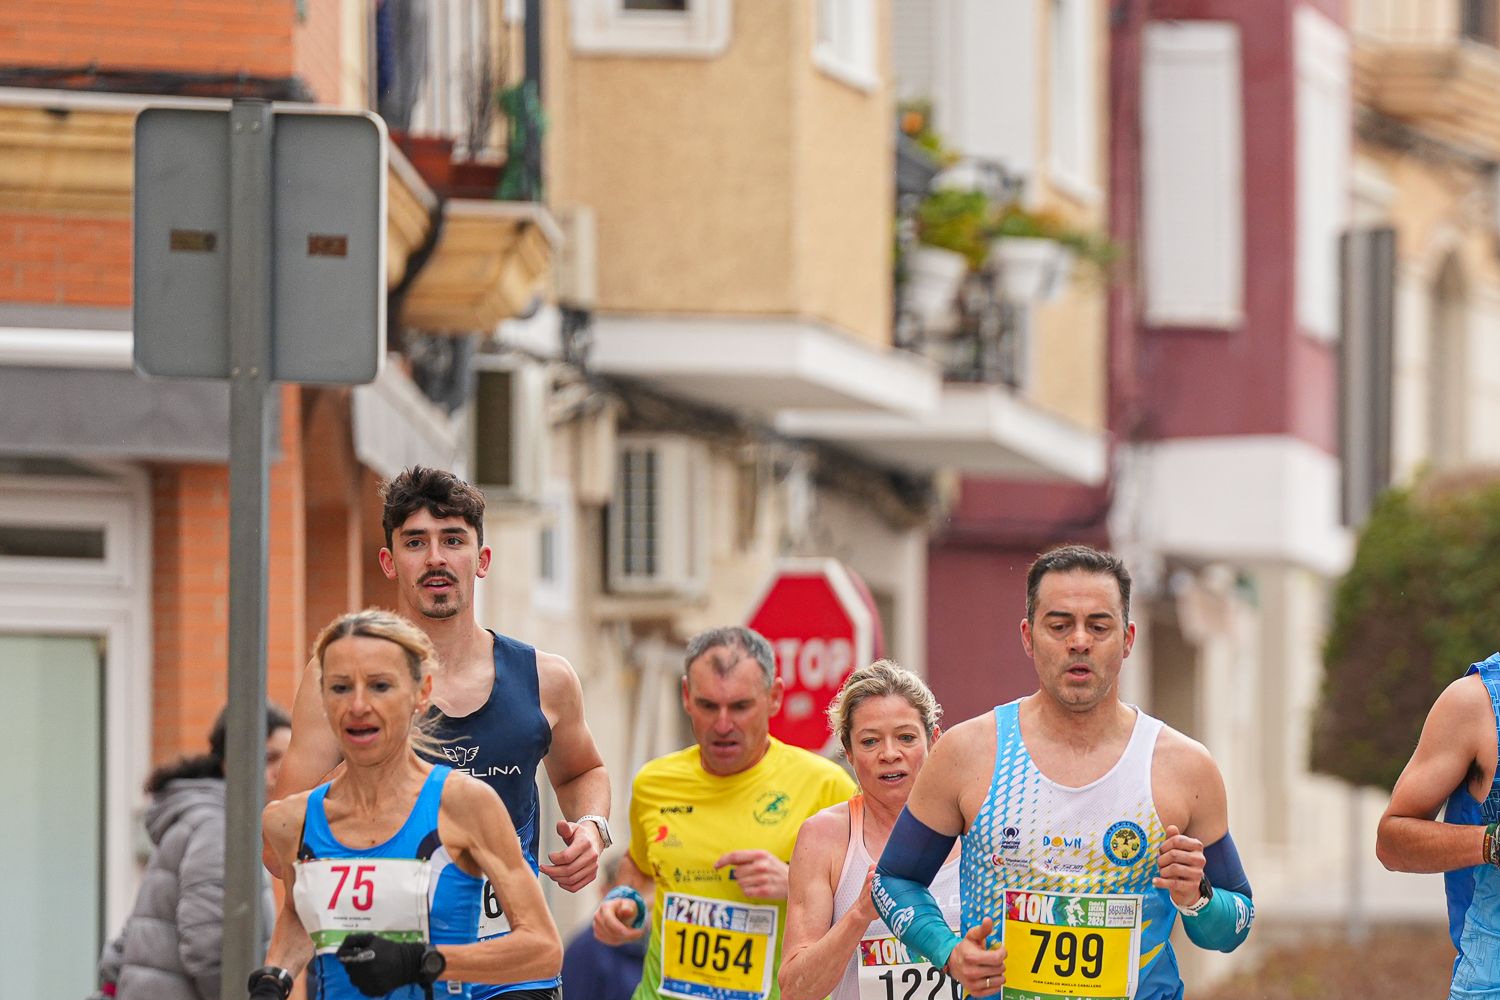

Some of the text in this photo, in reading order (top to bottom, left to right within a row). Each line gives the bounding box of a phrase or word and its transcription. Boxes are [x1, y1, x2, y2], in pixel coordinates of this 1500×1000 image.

[769, 636, 851, 690] TOP
[327, 866, 376, 911] 75
[1014, 893, 1056, 925] 10K
[676, 929, 753, 974] 1054
[1030, 929, 1104, 979] 799
